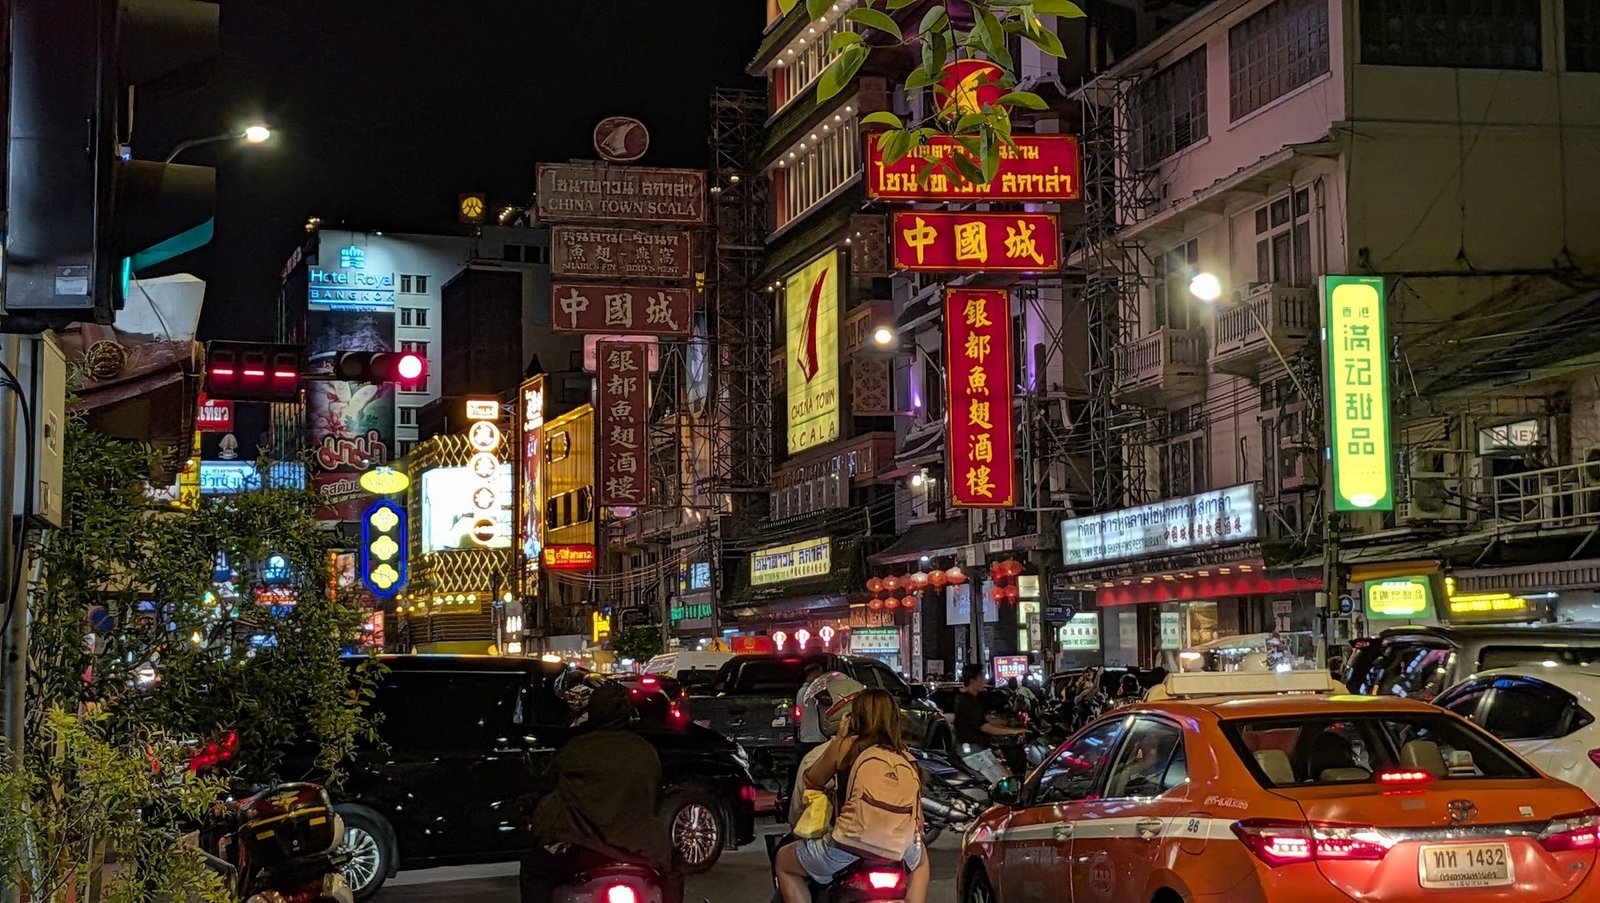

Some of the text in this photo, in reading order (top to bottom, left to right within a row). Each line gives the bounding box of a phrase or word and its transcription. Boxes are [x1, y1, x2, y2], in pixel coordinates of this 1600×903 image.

[1001, 165, 1072, 193] สกาล่า
[549, 198, 697, 216] CHINA TOWN SCALA
[903, 216, 1045, 265] 中國城
[311, 269, 395, 289] Hotel Royal
[311, 289, 395, 302] BANGKOK
[560, 287, 679, 331] 中國城
[791, 386, 835, 420] CHINA TOWN
[962, 298, 997, 499] 銀都魚翅酒樓
[605, 349, 641, 500] 銀都魚翅酒樓
[791, 420, 836, 451] SCALA
[1187, 818, 1200, 833] 26
[1466, 848, 1505, 867] 1432
